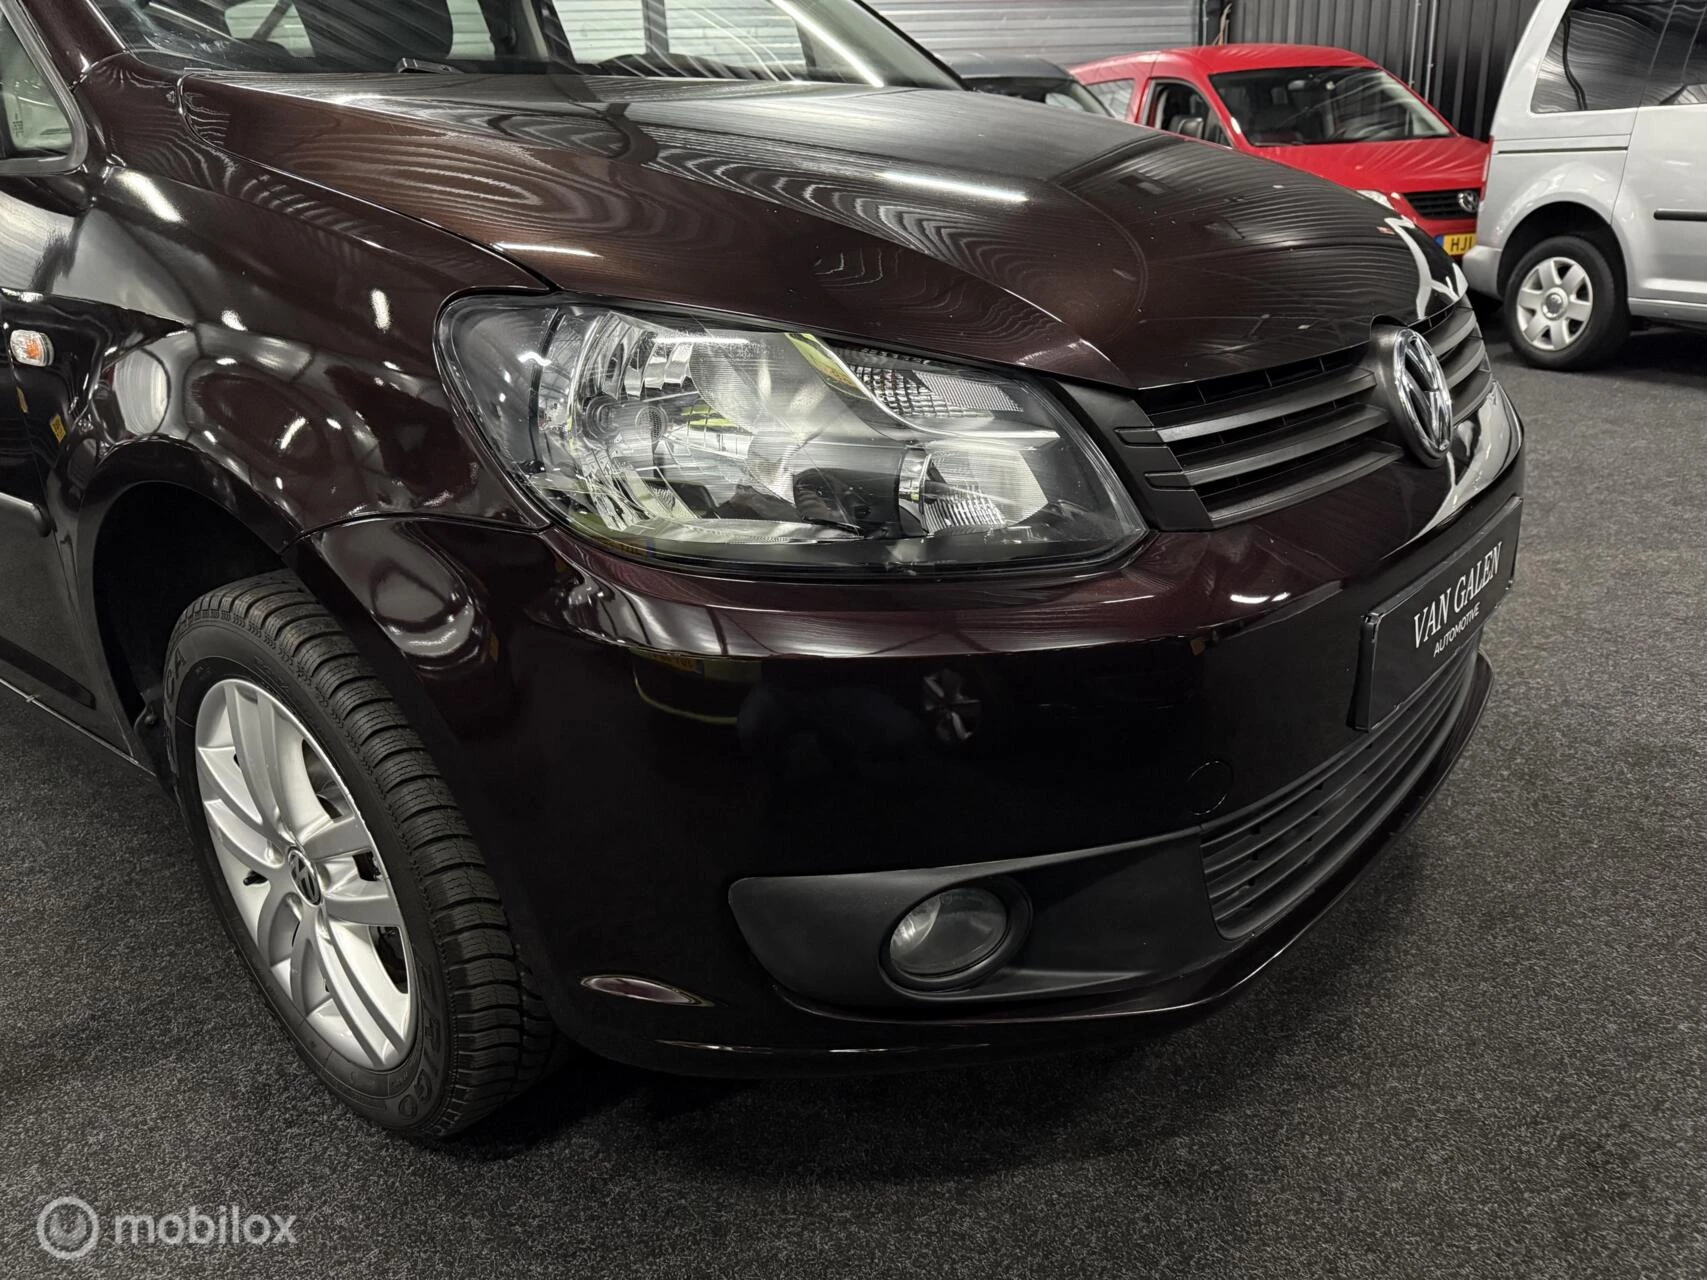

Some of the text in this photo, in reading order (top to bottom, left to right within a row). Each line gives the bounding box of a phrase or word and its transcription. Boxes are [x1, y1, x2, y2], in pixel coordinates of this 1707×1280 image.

[1414, 541, 1503, 649] VAN GALEN
[1433, 602, 1480, 658] AUTOMOTIVE
